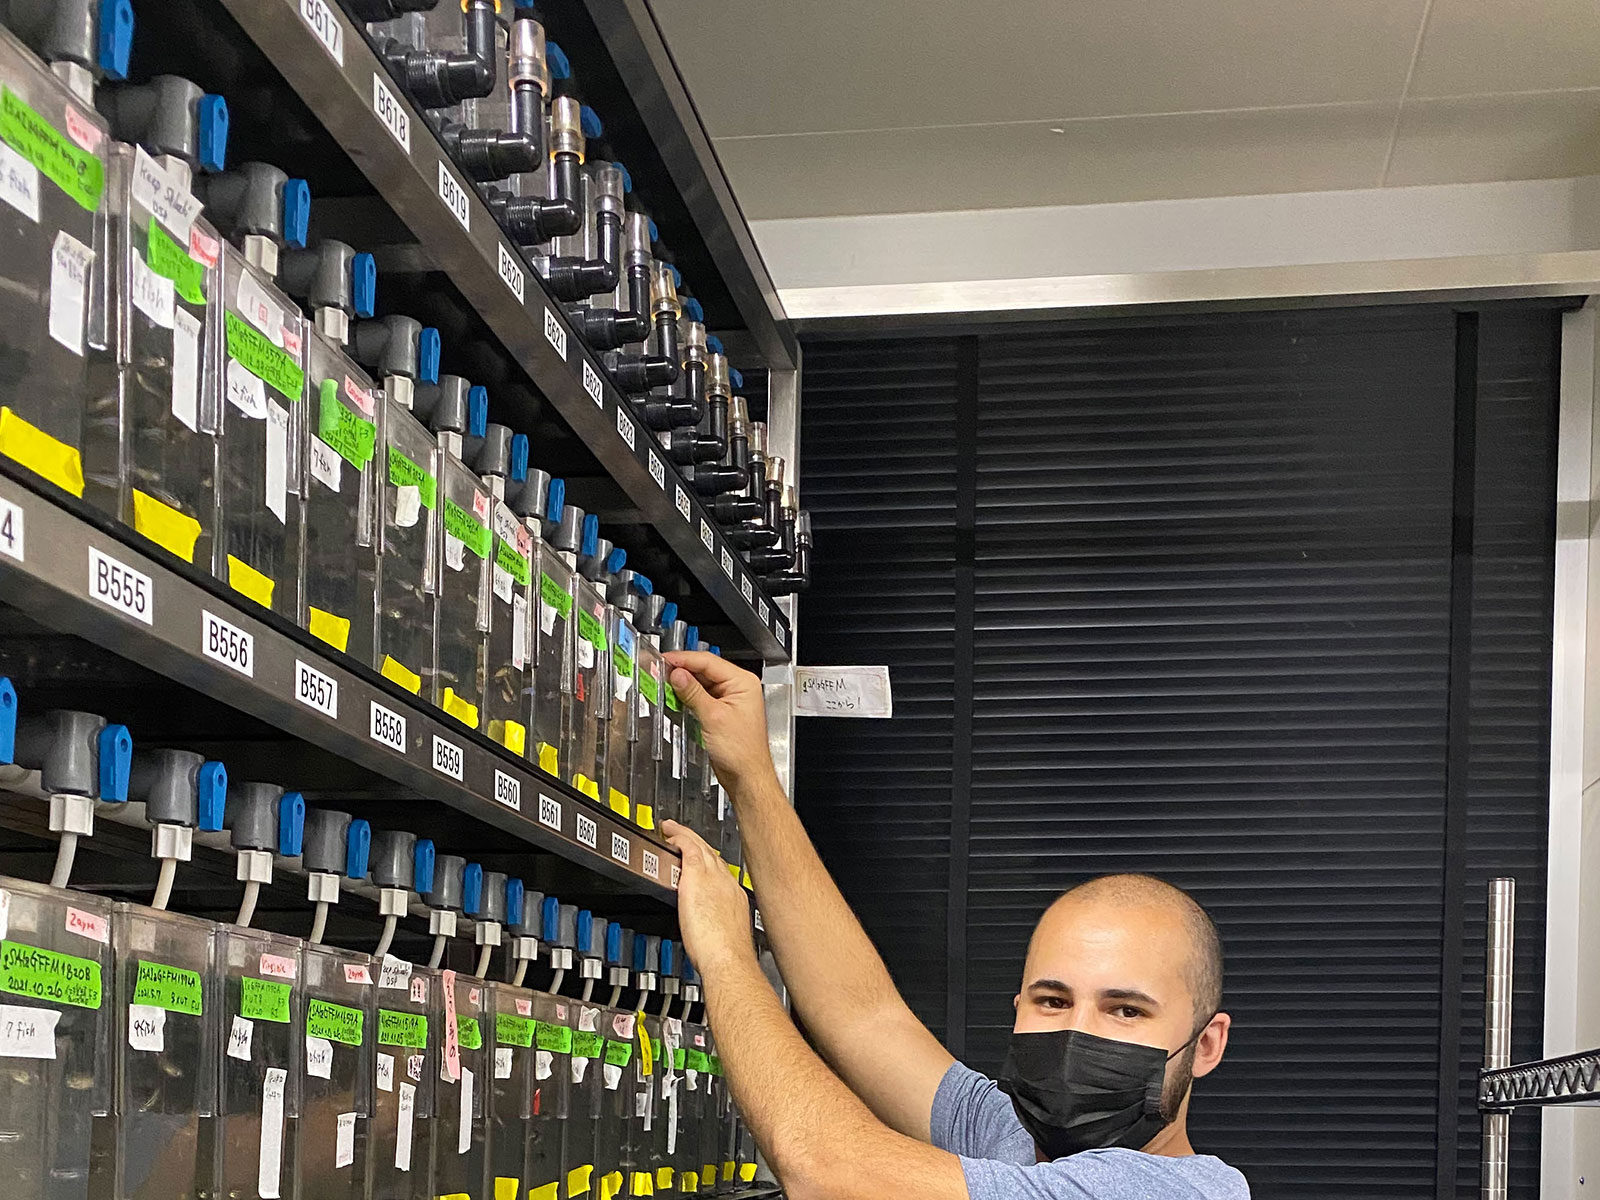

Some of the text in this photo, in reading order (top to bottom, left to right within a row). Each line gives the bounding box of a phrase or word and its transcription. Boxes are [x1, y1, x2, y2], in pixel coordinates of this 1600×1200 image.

[306, 0, 339, 52] B617
[378, 86, 407, 142] B618
[442, 173, 467, 220] B619
[501, 252, 523, 296] B620
[547, 314, 564, 355] B621
[585, 366, 601, 403] B622
[618, 413, 635, 445] B623
[97, 557, 146, 614] B555
[208, 619, 249, 668] B556
[300, 668, 333, 711] B557
[375, 709, 403, 746] B558
[436, 741, 460, 775] B559
[497, 774, 518, 805] B560
[541, 799, 559, 826] B561
[578, 818, 595, 845] B562
[612, 836, 628, 861] B563
